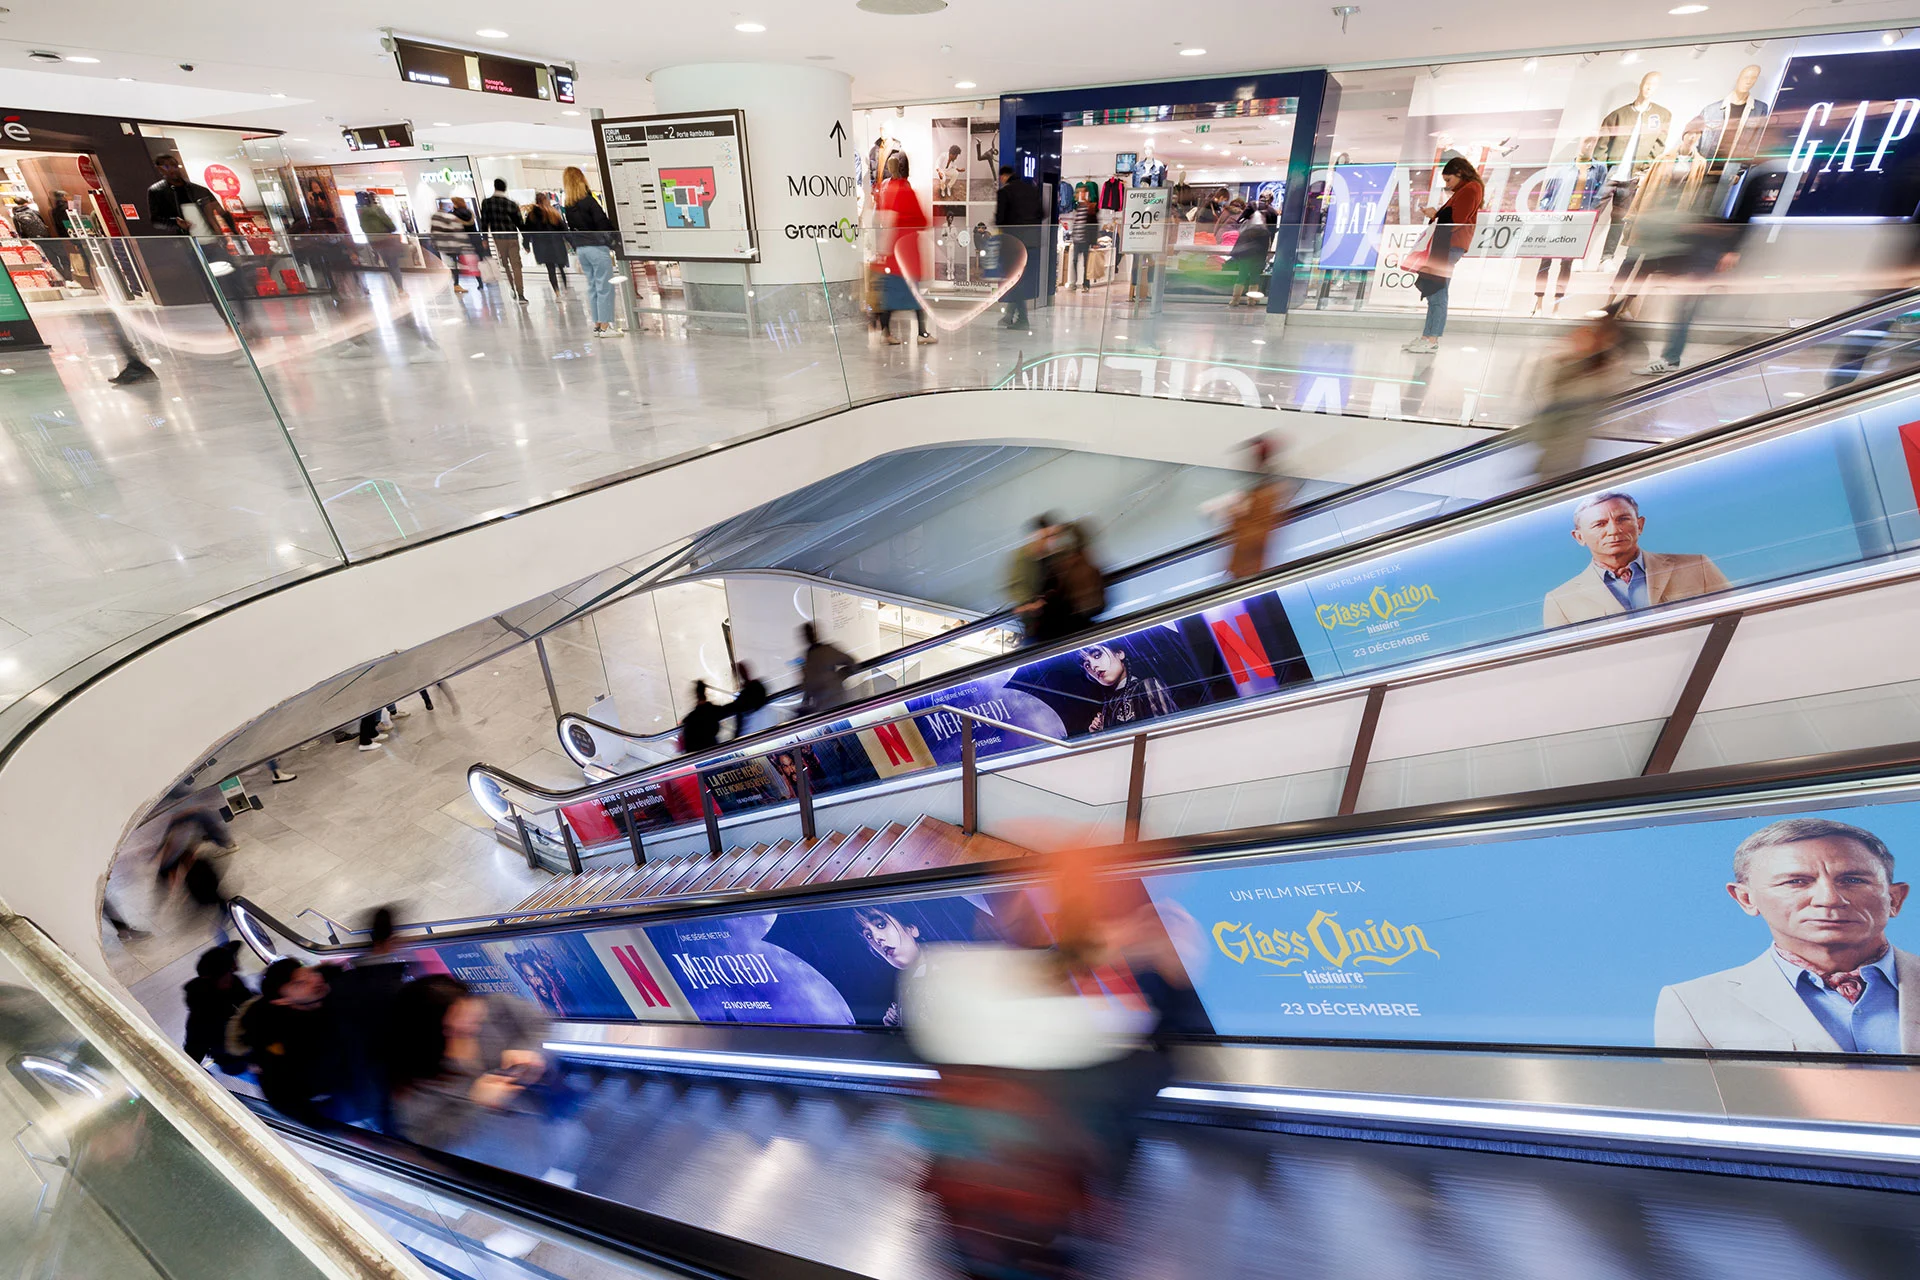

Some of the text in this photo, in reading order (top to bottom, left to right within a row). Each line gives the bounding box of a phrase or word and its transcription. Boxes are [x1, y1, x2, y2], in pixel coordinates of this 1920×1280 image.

[664, 126, 675, 139] -2
[689, 129, 715, 137] Rambuteau
[1786, 97, 1920, 174] GAP
[1143, 197, 1165, 206] SAISON
[1129, 210, 1161, 230] 20€
[1334, 201, 1379, 235] GAP
[1388, 232, 1419, 249] NE
[1535, 234, 1578, 244] réuction
[1379, 272, 1416, 289] ICO
[1325, 563, 1402, 591] UN FILM NETFLIX
[1315, 584, 1440, 631] Glass Onion
[1366, 620, 1400, 634] histoire
[1353, 647, 1368, 658] 23
[1367, 632, 1431, 654] DÉCEMBRE
[957, 687, 979, 697] NETFLIX
[707, 763, 764, 787] LA PETITE NEMO
[628, 786, 645, 797] vous
[601, 809, 611, 817] en
[626, 803, 637, 812] au
[636, 794, 665, 809] réveillon
[1229, 880, 1366, 902] UN FILM NETFLIX
[680, 931, 731, 942] UNE SÉRIE NETFLIX
[1212, 920, 1310, 968] Glass
[1306, 909, 1441, 968] Onion
[672, 953, 779, 989] MERCREDI
[1301, 968, 1364, 985] histoire
[722, 1001, 772, 1010] 23 NOVEMBRE
[1280, 999, 1422, 1016] 23 DÉCEMBRE
